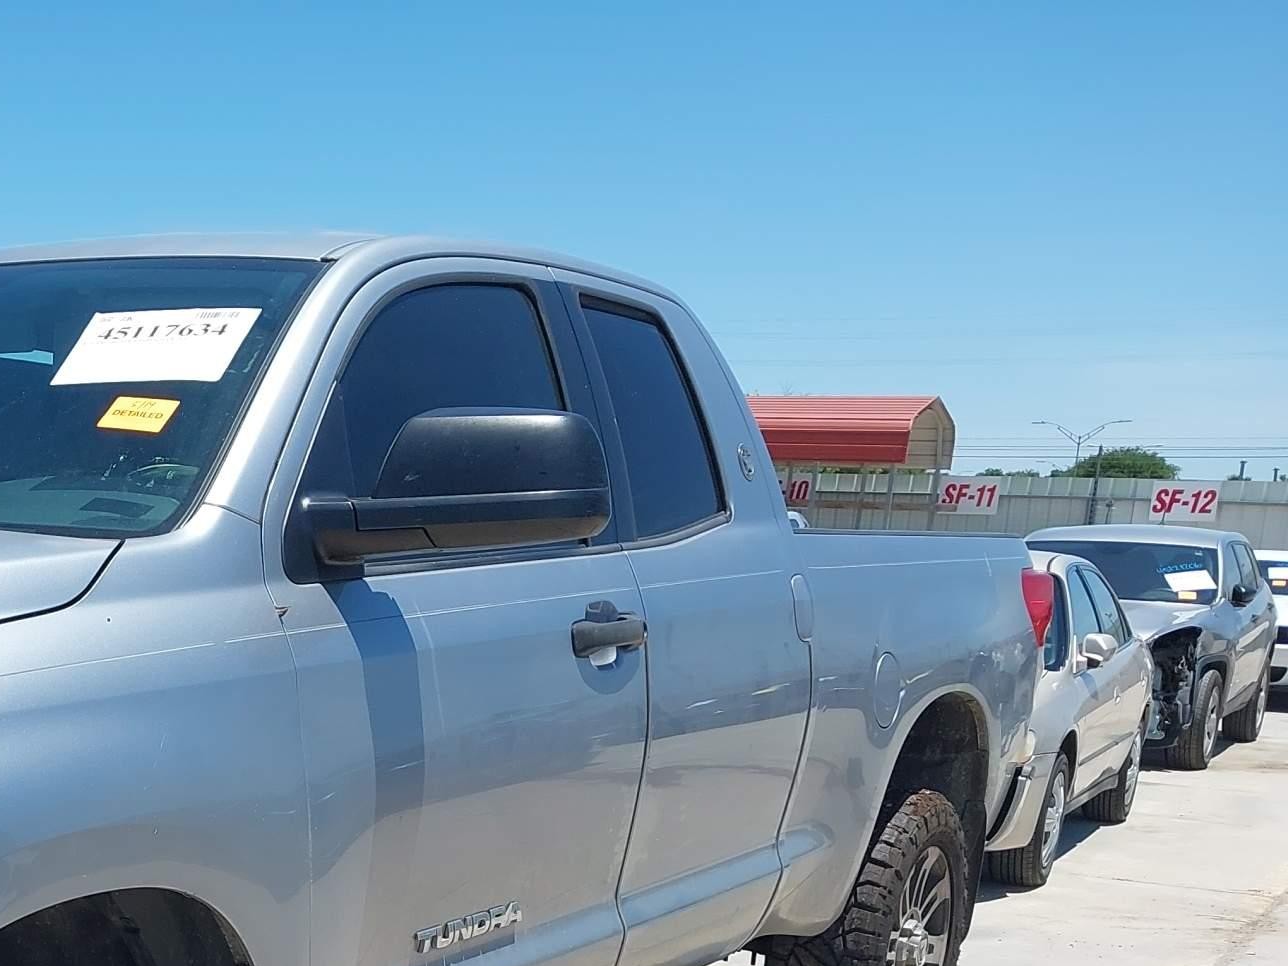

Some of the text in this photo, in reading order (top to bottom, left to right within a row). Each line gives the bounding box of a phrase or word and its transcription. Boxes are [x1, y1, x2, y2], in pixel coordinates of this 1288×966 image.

[97, 323, 229, 340] 45117634
[112, 409, 164, 419] DETAILED
[941, 483, 997, 507] SF-11
[1152, 488, 1217, 513] SF-12
[414, 901, 523, 953] TUNDRA
